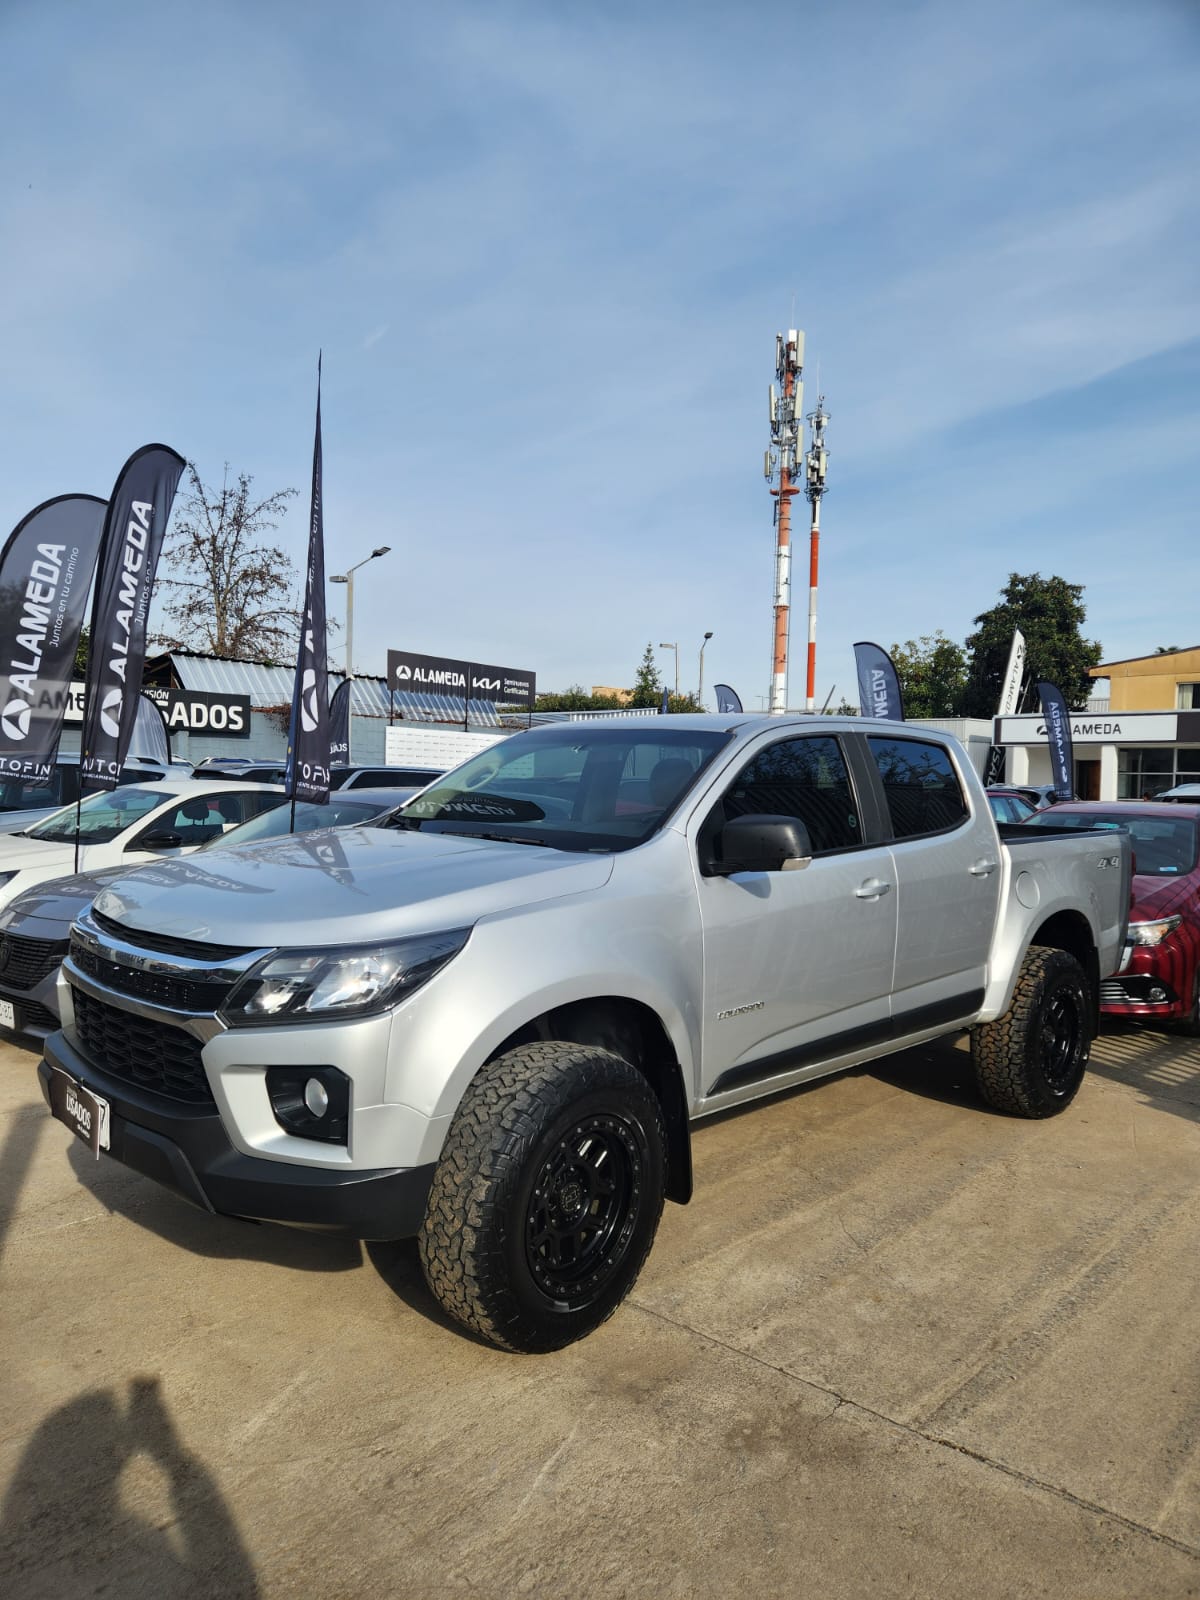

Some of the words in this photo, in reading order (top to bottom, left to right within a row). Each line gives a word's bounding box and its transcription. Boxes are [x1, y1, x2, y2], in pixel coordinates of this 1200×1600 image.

[64, 546, 79, 584] camino
[58, 598, 66, 611] en
[61, 586, 70, 598] tu
[109, 500, 152, 683] ALAMEDA
[135, 585, 150, 626] Juntos
[9, 543, 66, 695] ALAMEDA
[50, 614, 65, 647] Juntos
[413, 668, 466, 687] ALAMEDA
[1072, 723, 1122, 735] AMEDA
[66, 1093, 91, 1130] USADOS
